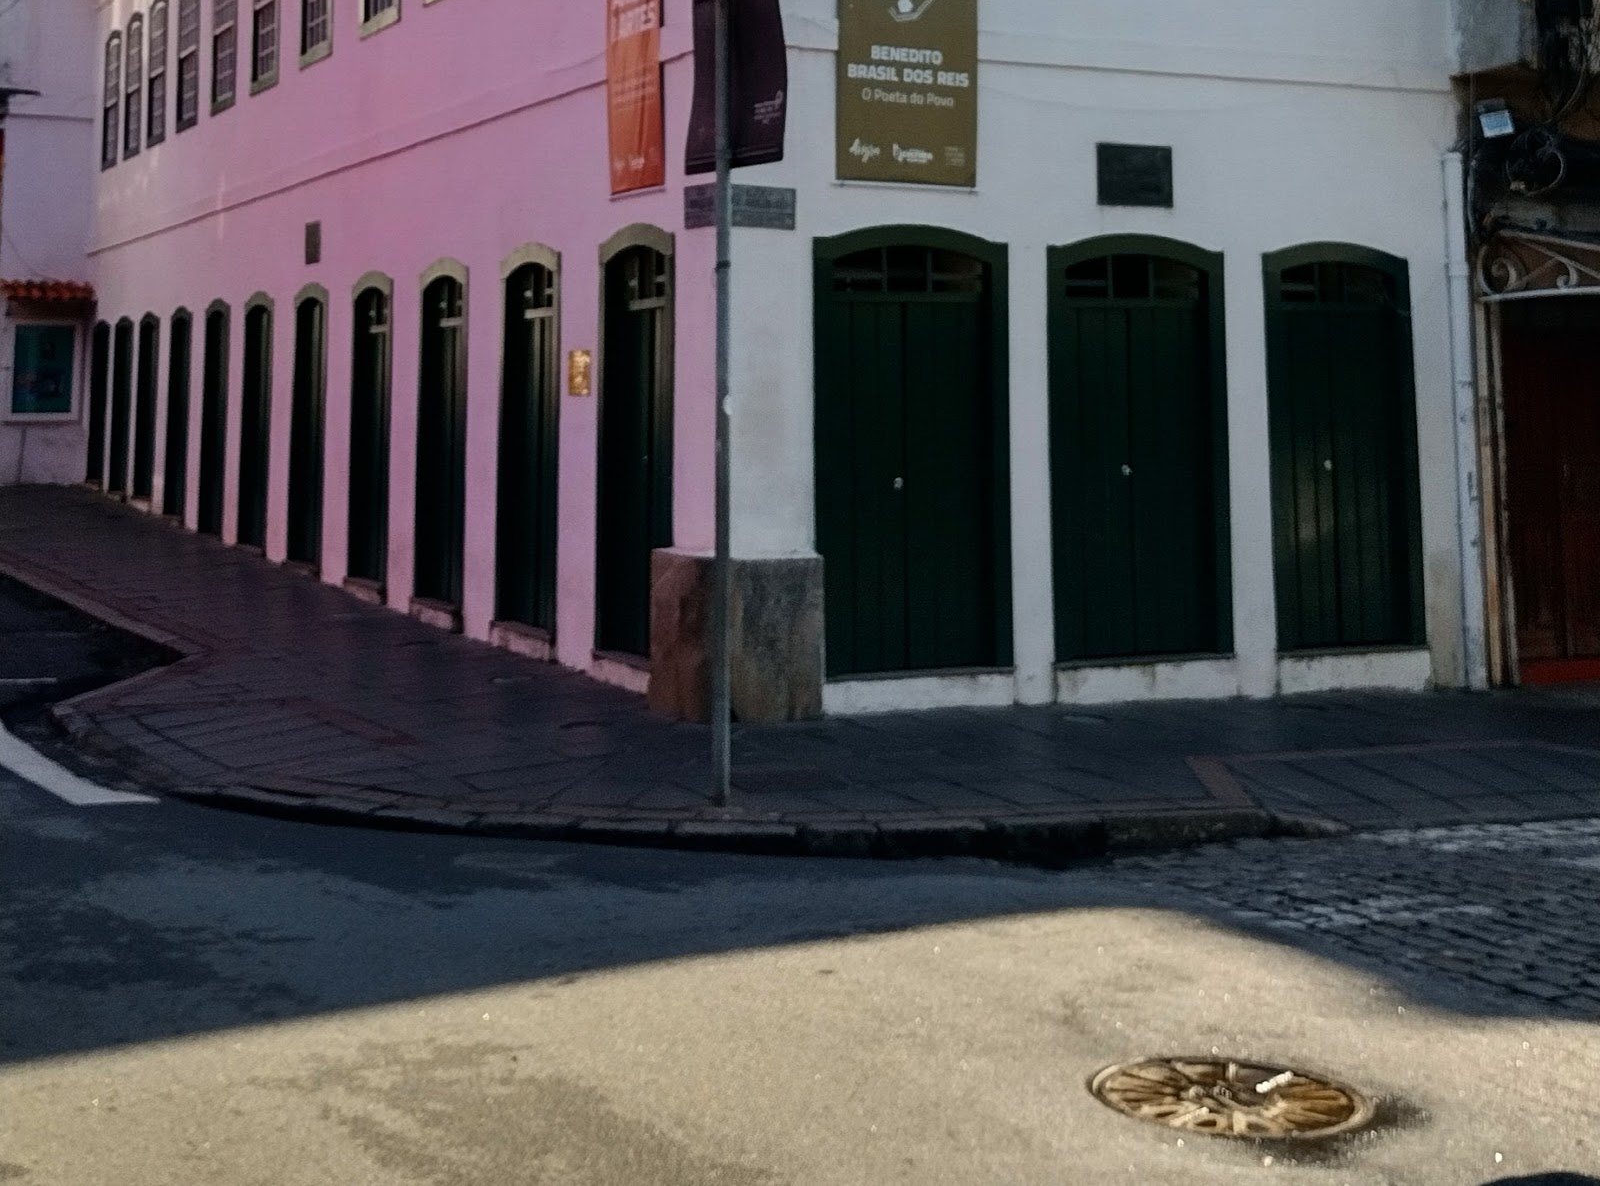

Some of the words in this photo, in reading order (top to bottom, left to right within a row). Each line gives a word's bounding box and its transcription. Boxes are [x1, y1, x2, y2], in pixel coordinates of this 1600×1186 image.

[871, 45, 943, 65] BENEDITO
[847, 63, 899, 82] BRASIL
[902, 68, 934, 84] DOS
[937, 71, 969, 87] REIS
[861, 88, 872, 102] O
[874, 89, 907, 103] Poeta
[910, 93, 924, 105] do
[927, 94, 954, 107] Povo
